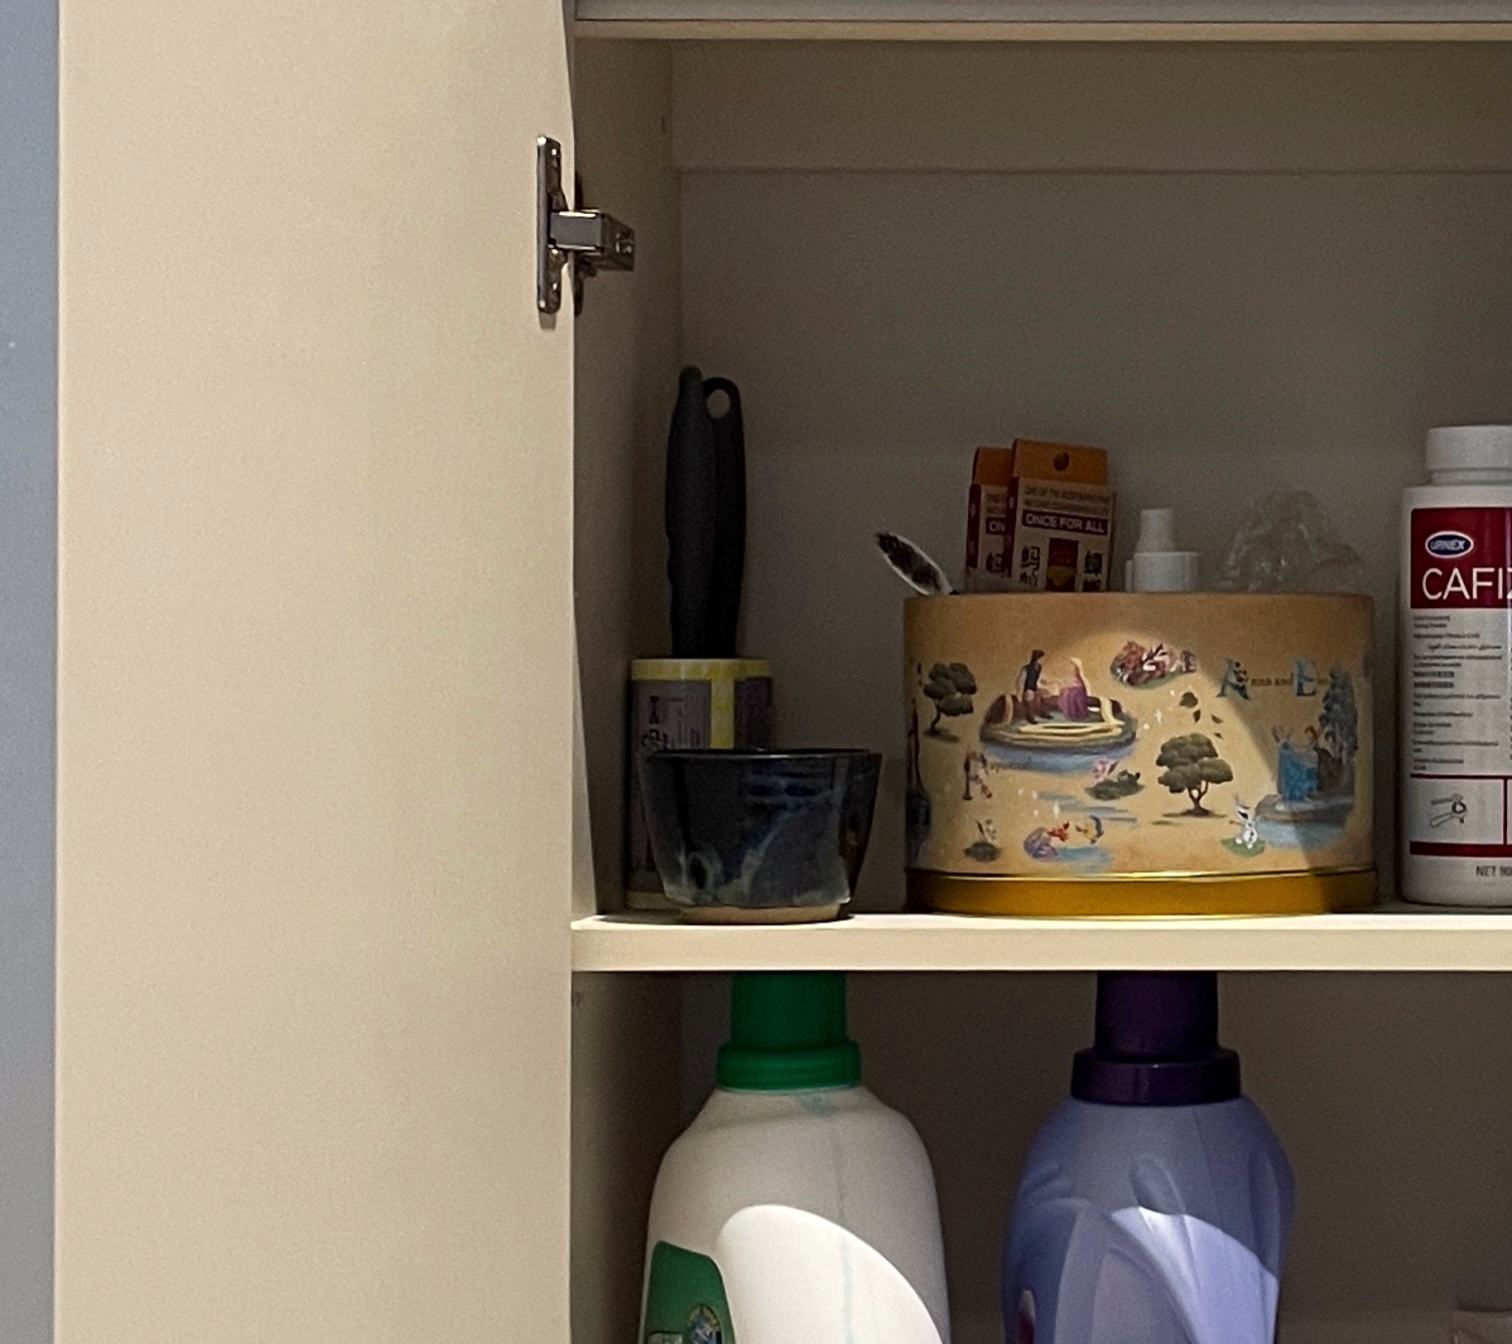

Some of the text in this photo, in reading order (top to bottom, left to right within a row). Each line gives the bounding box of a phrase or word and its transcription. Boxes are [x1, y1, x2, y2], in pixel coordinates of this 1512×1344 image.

[1025, 513, 1105, 533] ONCE FOR ALL
